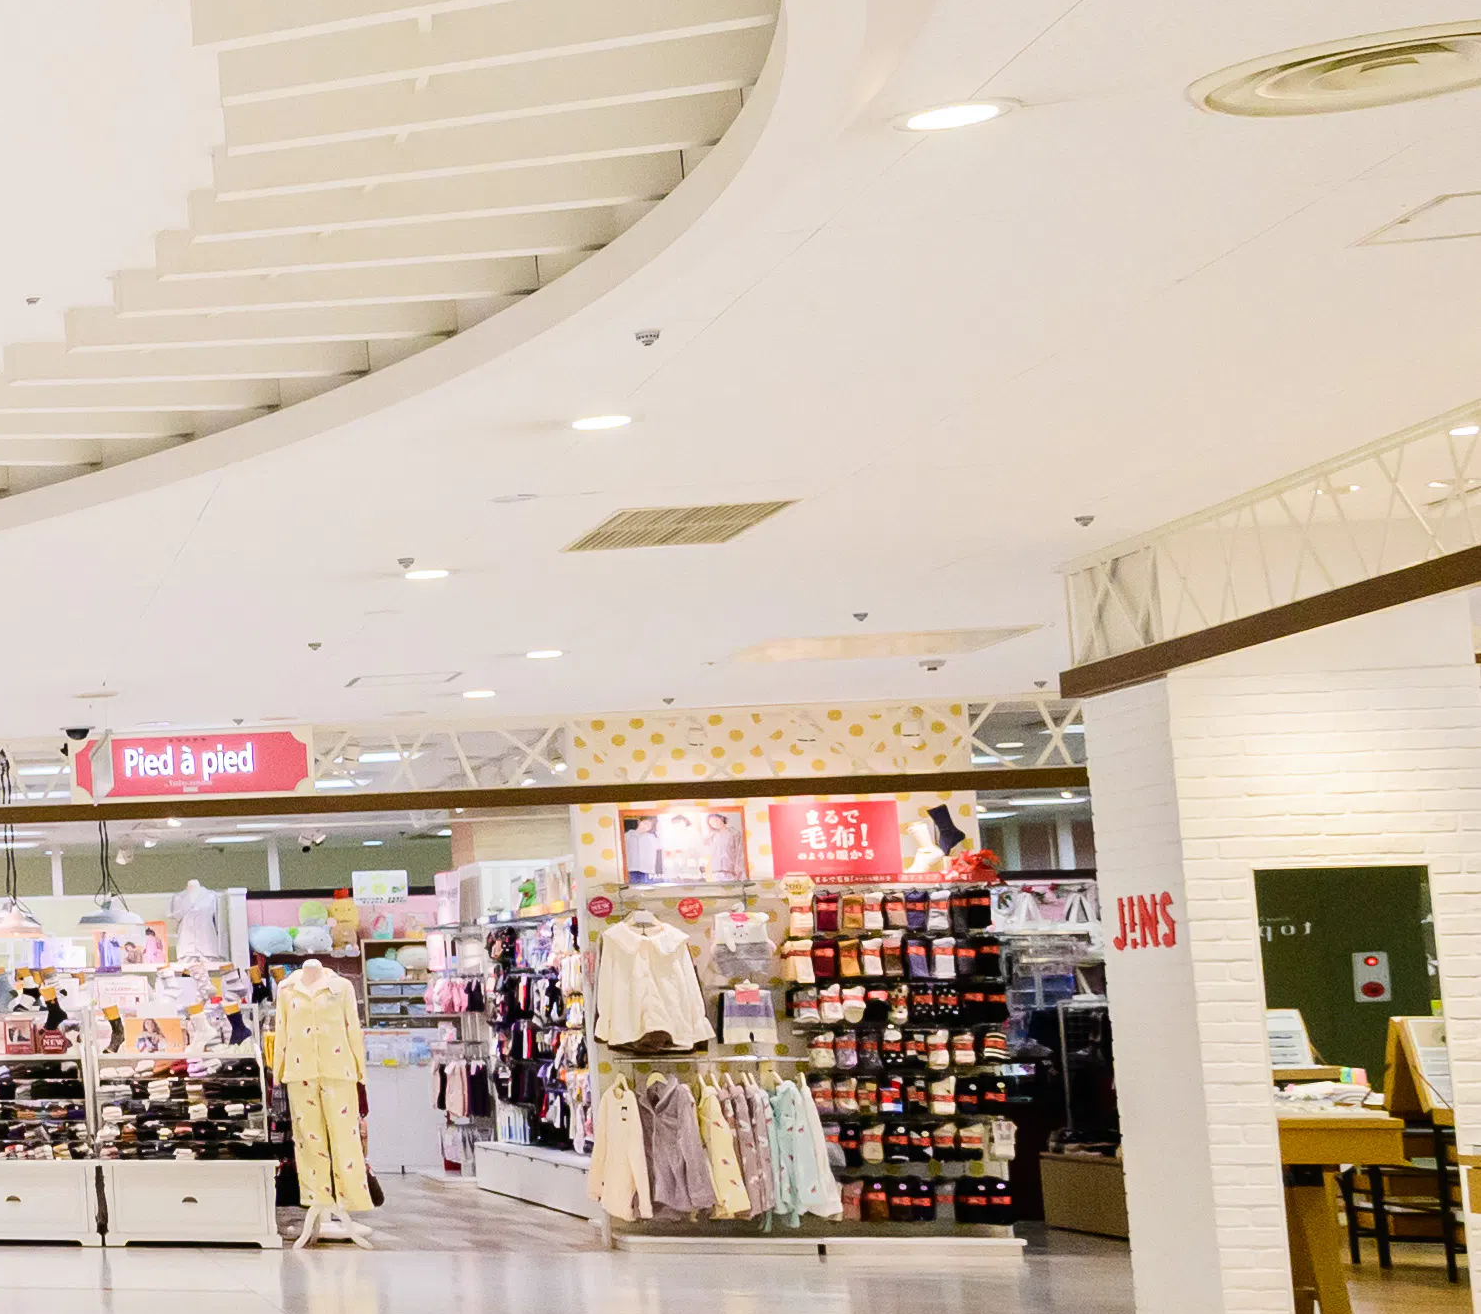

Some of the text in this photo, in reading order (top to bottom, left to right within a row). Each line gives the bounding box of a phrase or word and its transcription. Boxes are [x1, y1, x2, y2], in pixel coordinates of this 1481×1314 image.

[123, 741, 255, 781] Pied à pied
[805, 809, 860, 826] まるで
